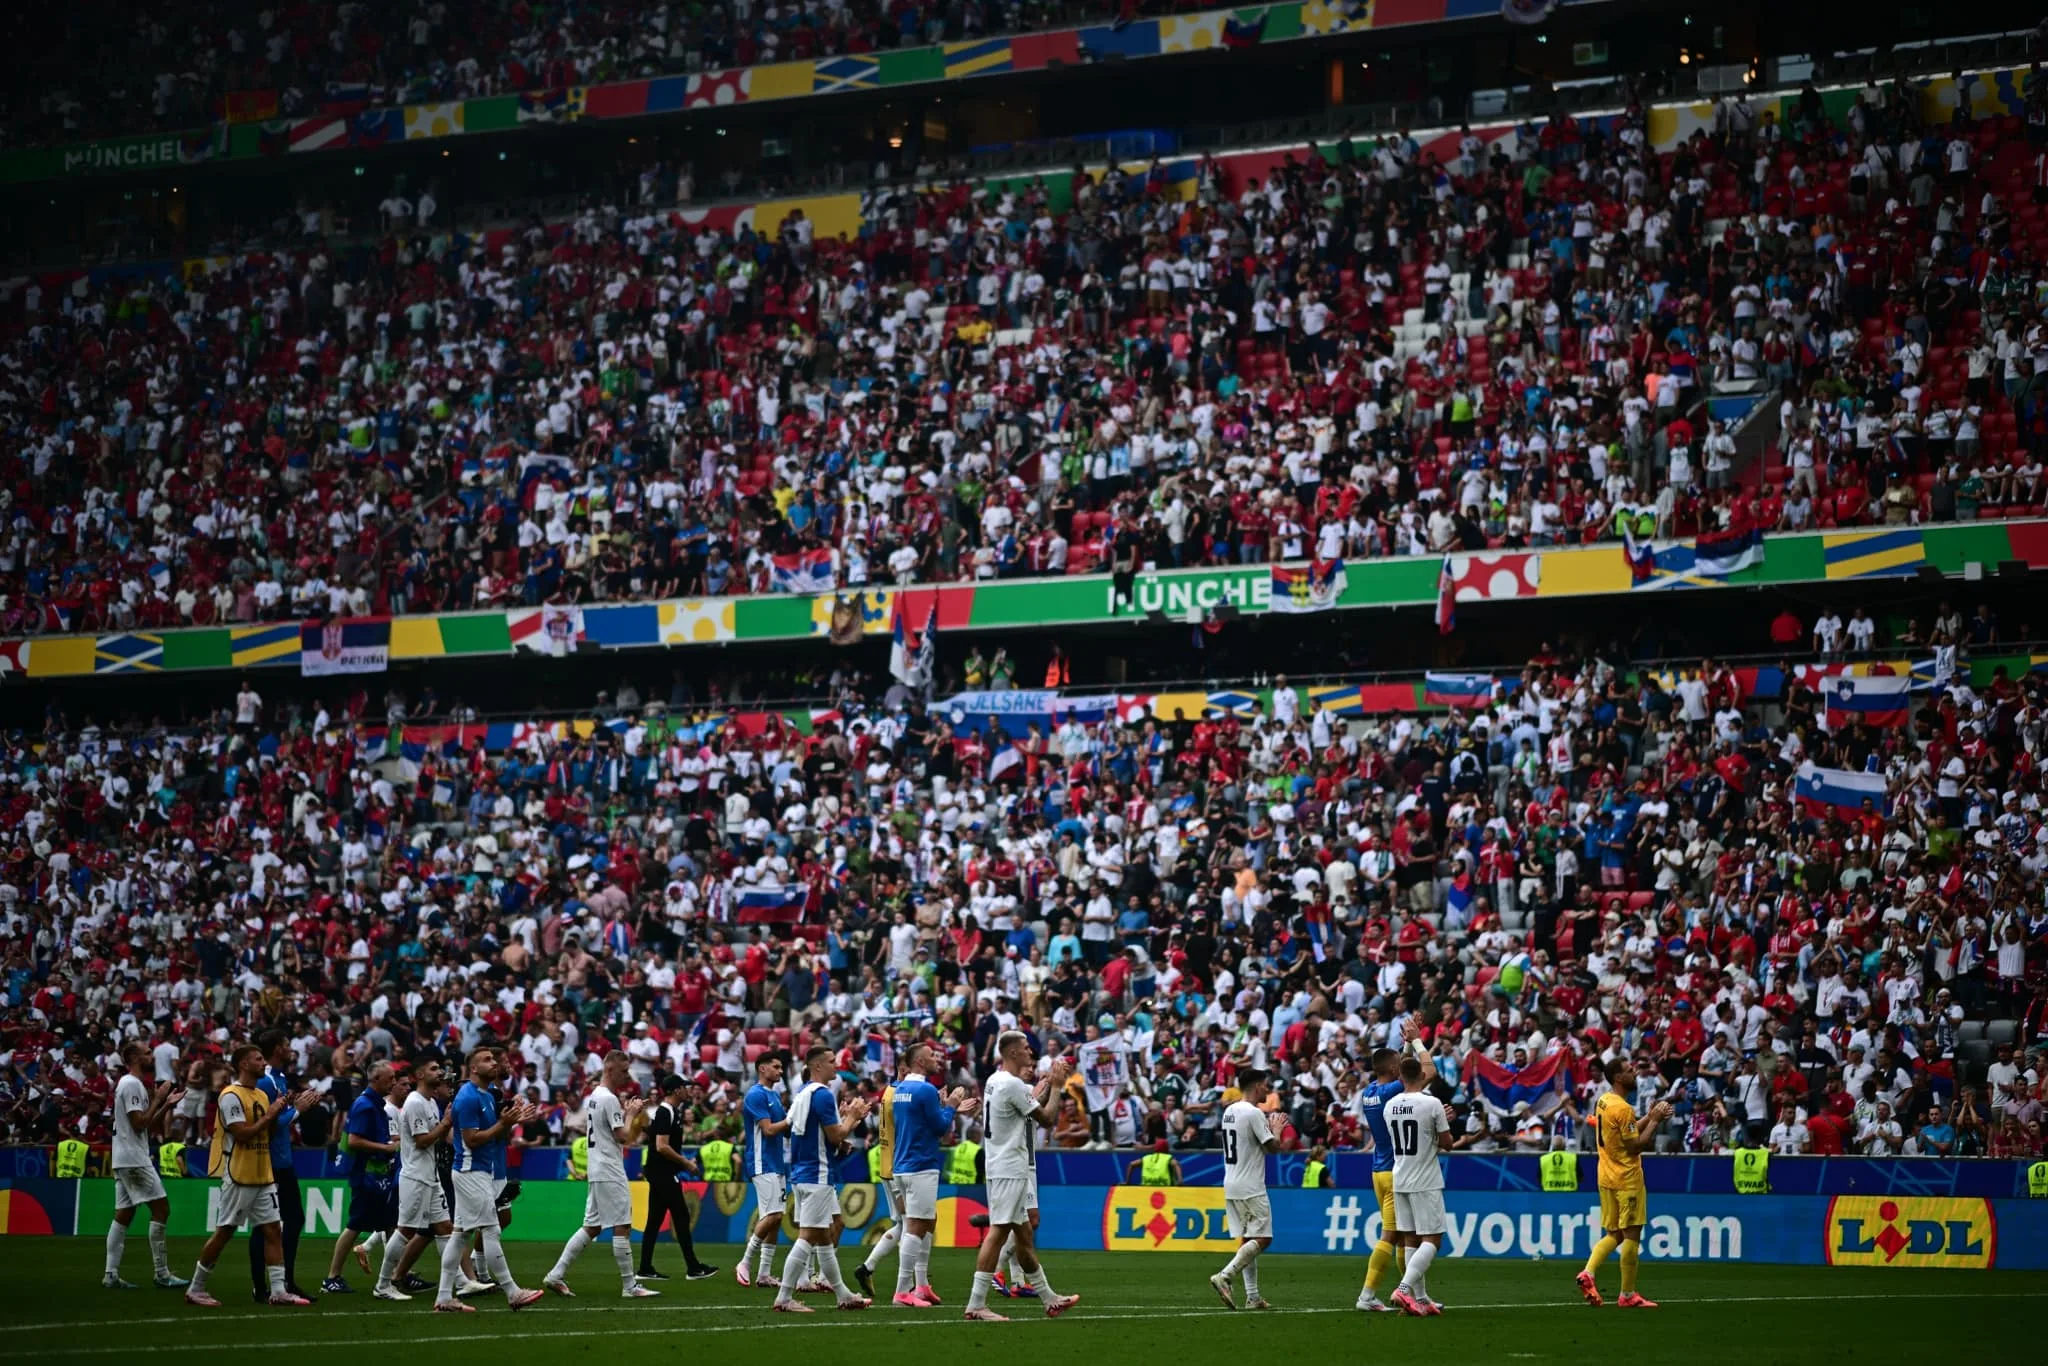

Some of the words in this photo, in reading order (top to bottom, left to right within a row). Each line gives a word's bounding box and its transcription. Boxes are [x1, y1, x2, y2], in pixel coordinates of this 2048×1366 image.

[1223, 1129, 1238, 1164] 13
[1391, 1119, 1418, 1156] 10
[1114, 1191, 1231, 1248] LIDL
[1837, 1201, 1983, 1263] LIDL
